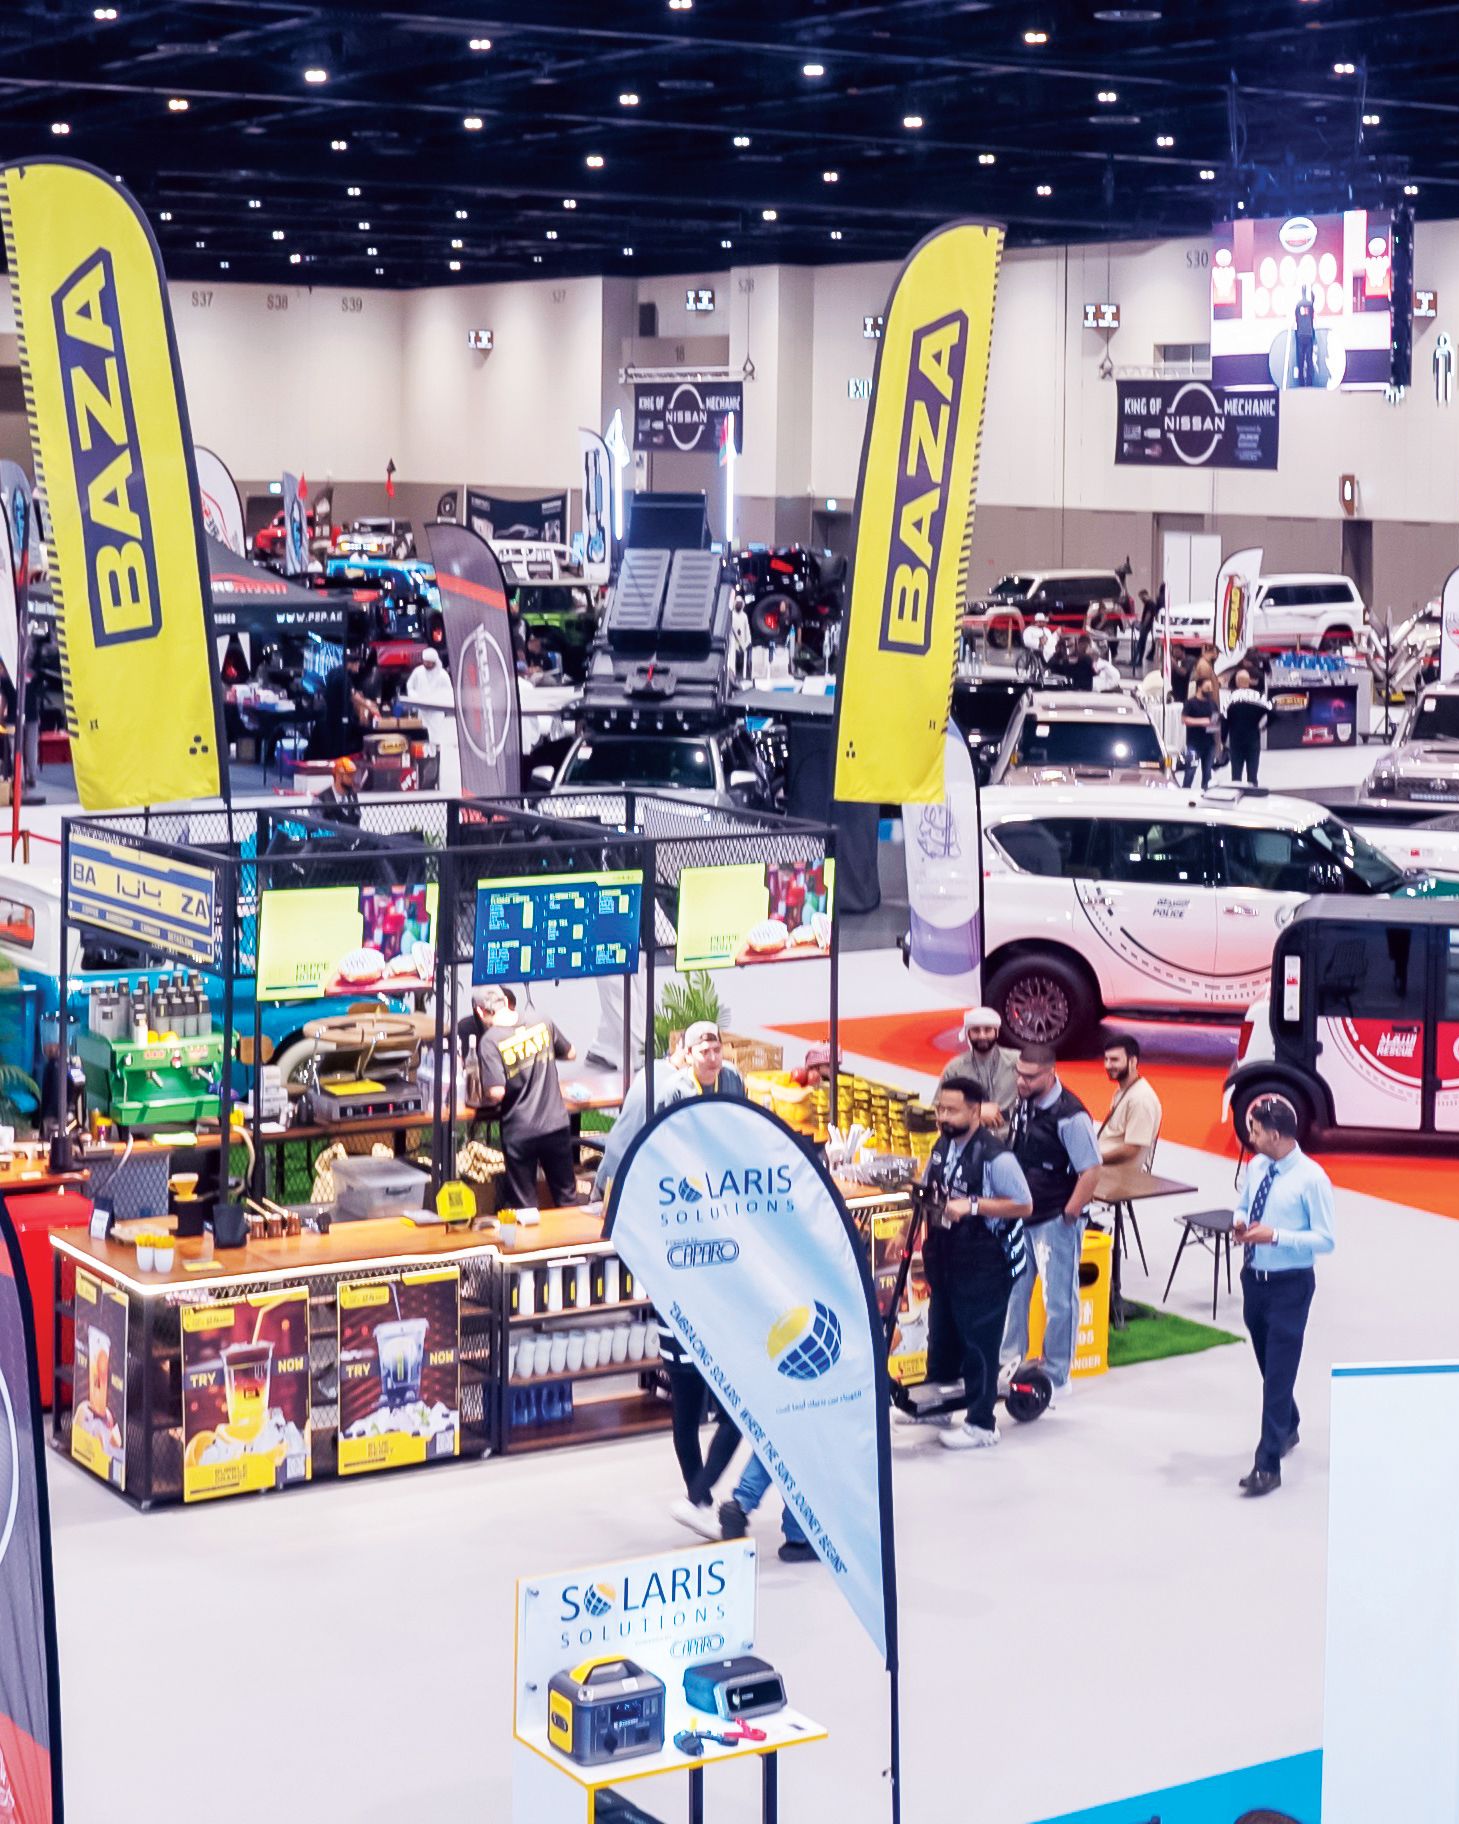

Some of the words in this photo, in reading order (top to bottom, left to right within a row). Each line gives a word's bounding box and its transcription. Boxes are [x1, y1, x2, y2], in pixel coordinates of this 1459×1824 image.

[1186, 250, 1209, 268] S30
[191, 290, 214, 307] S37
[267, 294, 288, 310] S38
[341, 297, 363, 312] S39
[1124, 397, 1147, 415] KING
[1150, 397, 1162, 415] OF
[1224, 398, 1275, 416] MECHANIC
[665, 411, 707, 423] NISSAN
[1164, 415, 1226, 432] NISSAN
[64, 261, 157, 635] BAZA
[888, 319, 961, 640] BAZA
[73, 862, 96, 886] BA
[181, 893, 208, 920] ZA
[1152, 908, 1184, 919] POLICE
[659, 1164, 792, 1206] SOLARIS
[660, 1199, 795, 1227] SOLUTIONS
[277, 1357, 304, 1374] NOW
[429, 1351, 454, 1366] NOW
[189, 1371, 217, 1388] TRY
[346, 1363, 371, 1379] TRY
[740, 1407, 767, 1443] WHERE
[763, 1440, 780, 1462] THE
[560, 1560, 726, 1622] SOLARIS
[561, 1603, 725, 1649] SOLUTIONS
